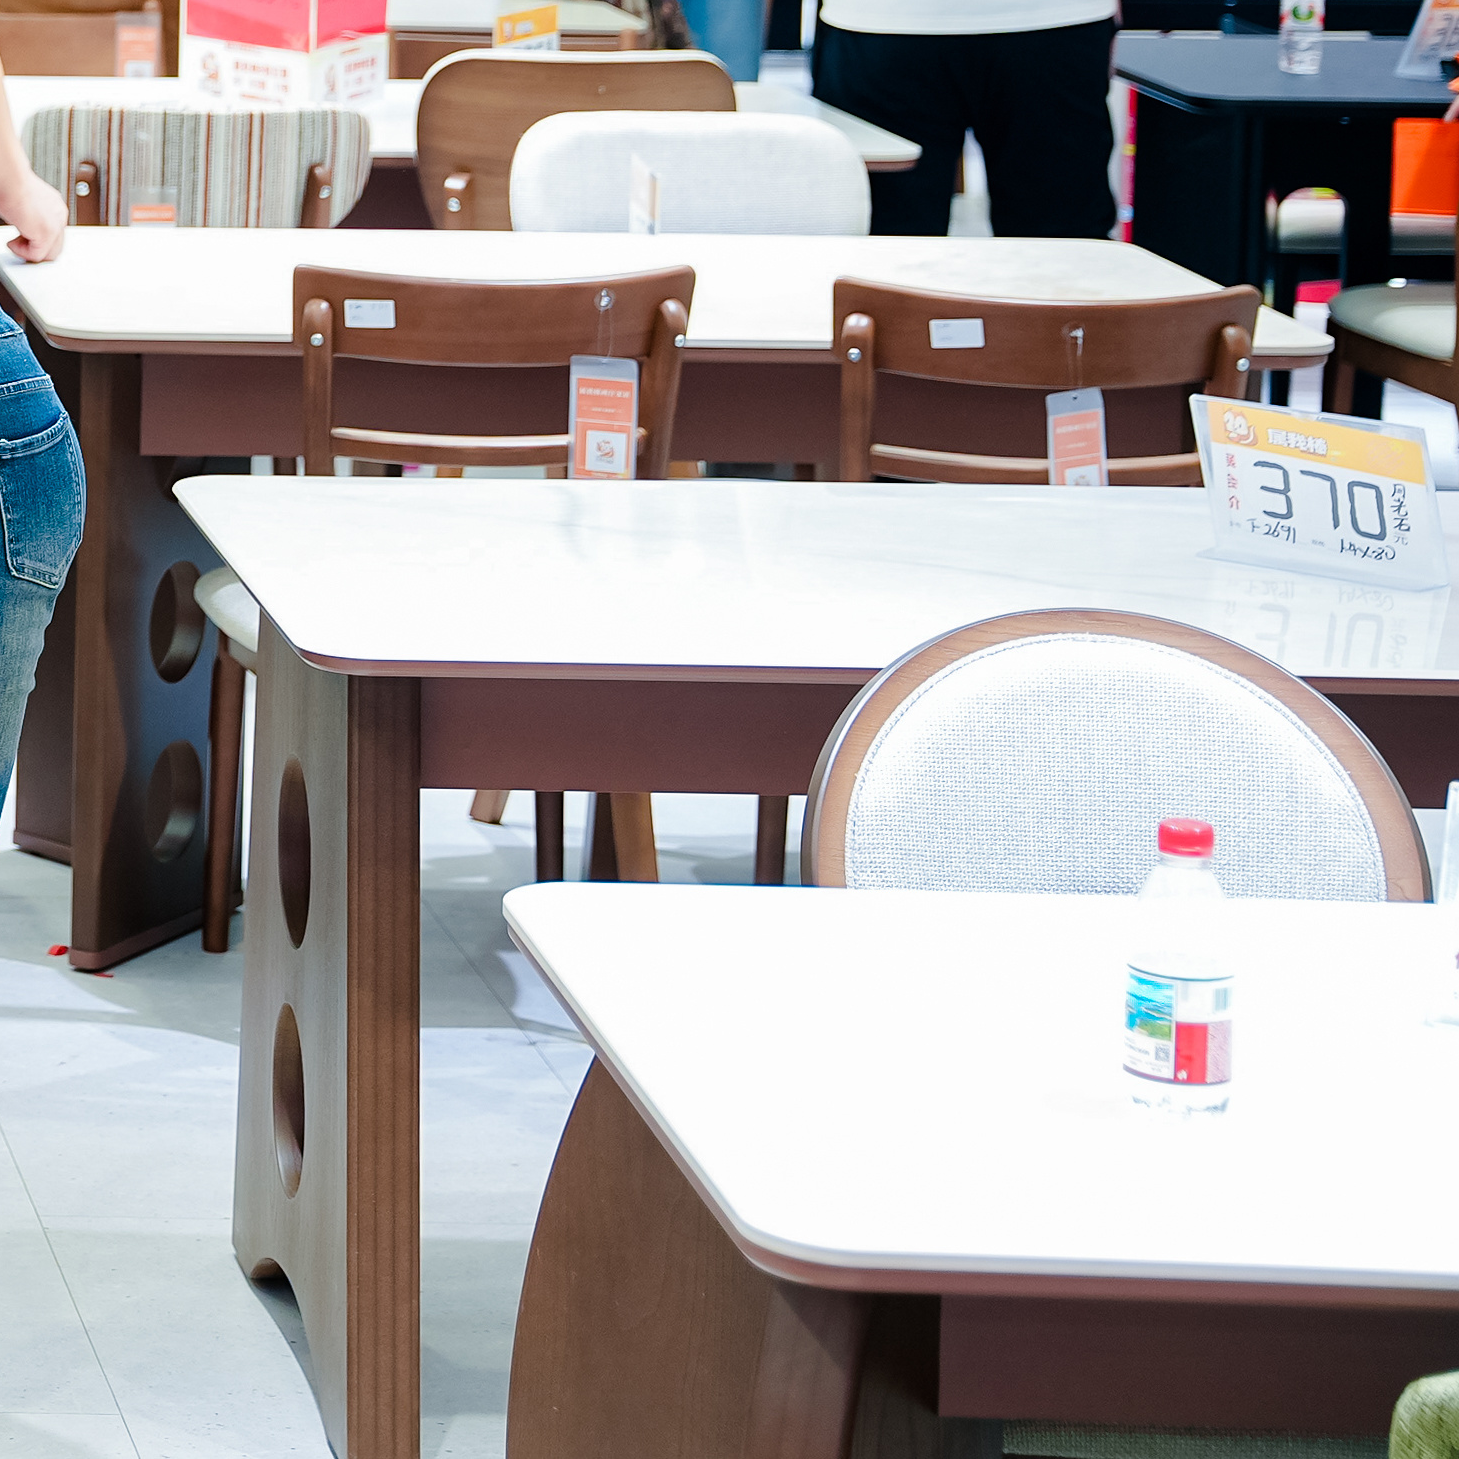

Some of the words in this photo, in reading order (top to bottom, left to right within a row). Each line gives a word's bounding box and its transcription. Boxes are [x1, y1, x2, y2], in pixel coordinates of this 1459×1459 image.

[1266, 427, 1329, 457] 属我棒
[1253, 460, 1387, 542] 370
